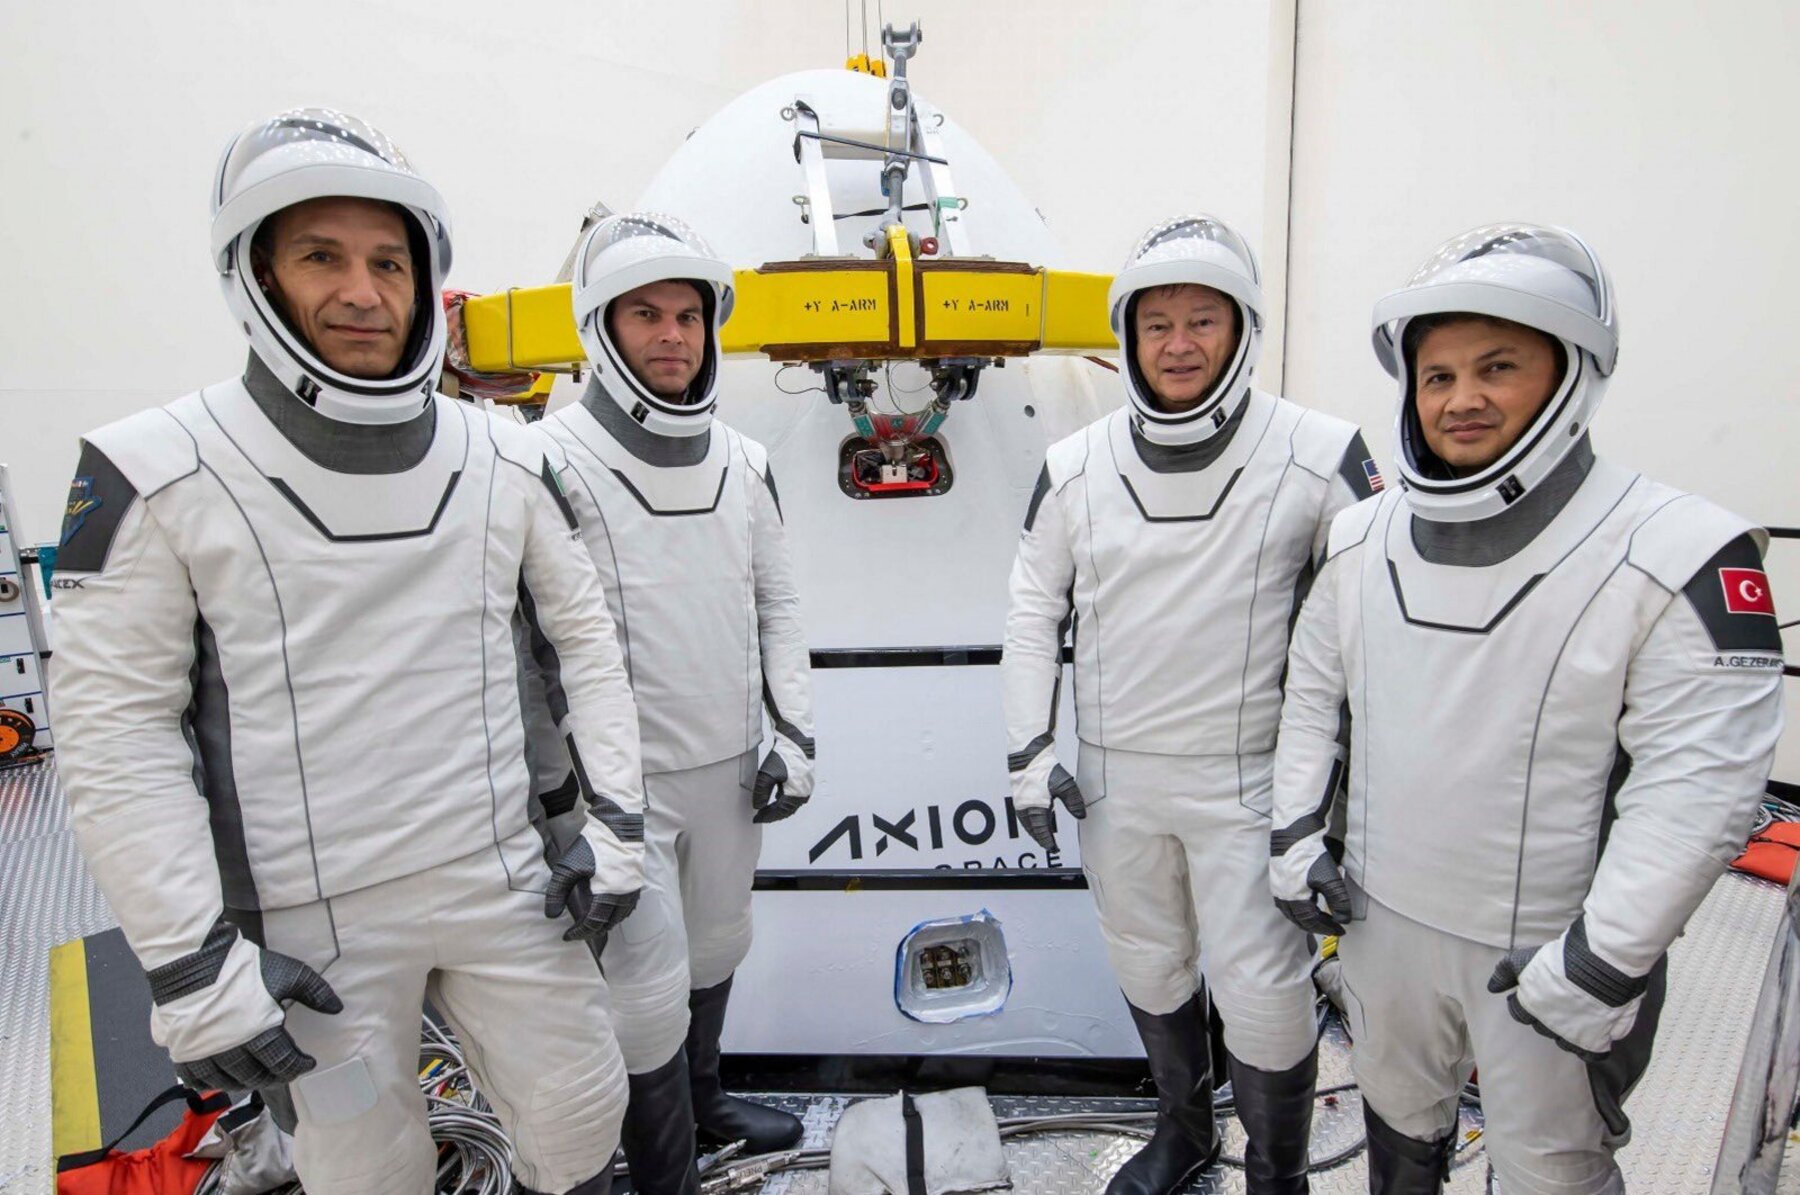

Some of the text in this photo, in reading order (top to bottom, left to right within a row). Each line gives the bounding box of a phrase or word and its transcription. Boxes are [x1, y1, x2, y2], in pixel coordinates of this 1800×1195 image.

[804, 299, 876, 312] +Y A-ARM
[943, 299, 1009, 311] +Y A-ARM
